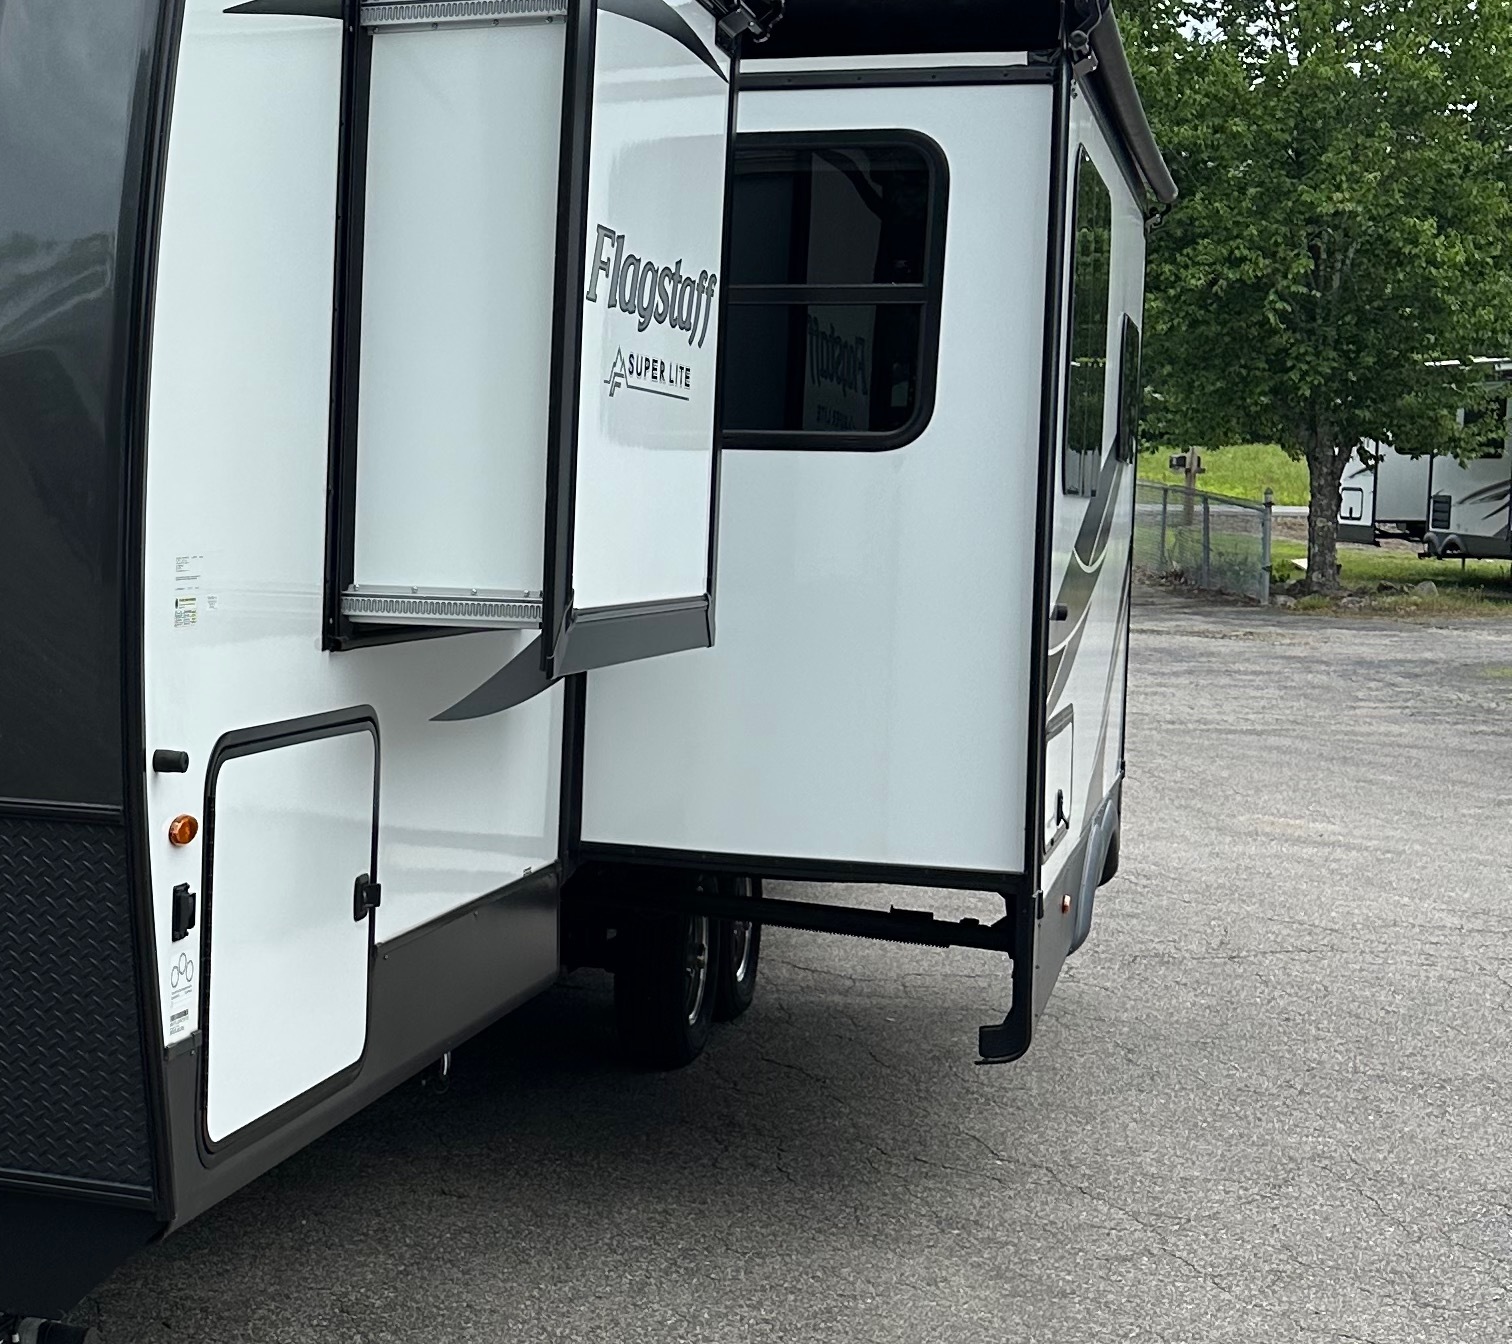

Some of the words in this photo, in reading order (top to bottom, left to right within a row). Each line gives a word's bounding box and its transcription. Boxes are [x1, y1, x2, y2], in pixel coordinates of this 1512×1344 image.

[586, 223, 717, 348] Flagstaff
[628, 353, 666, 384] SUPER
[669, 362, 691, 390] LITE
